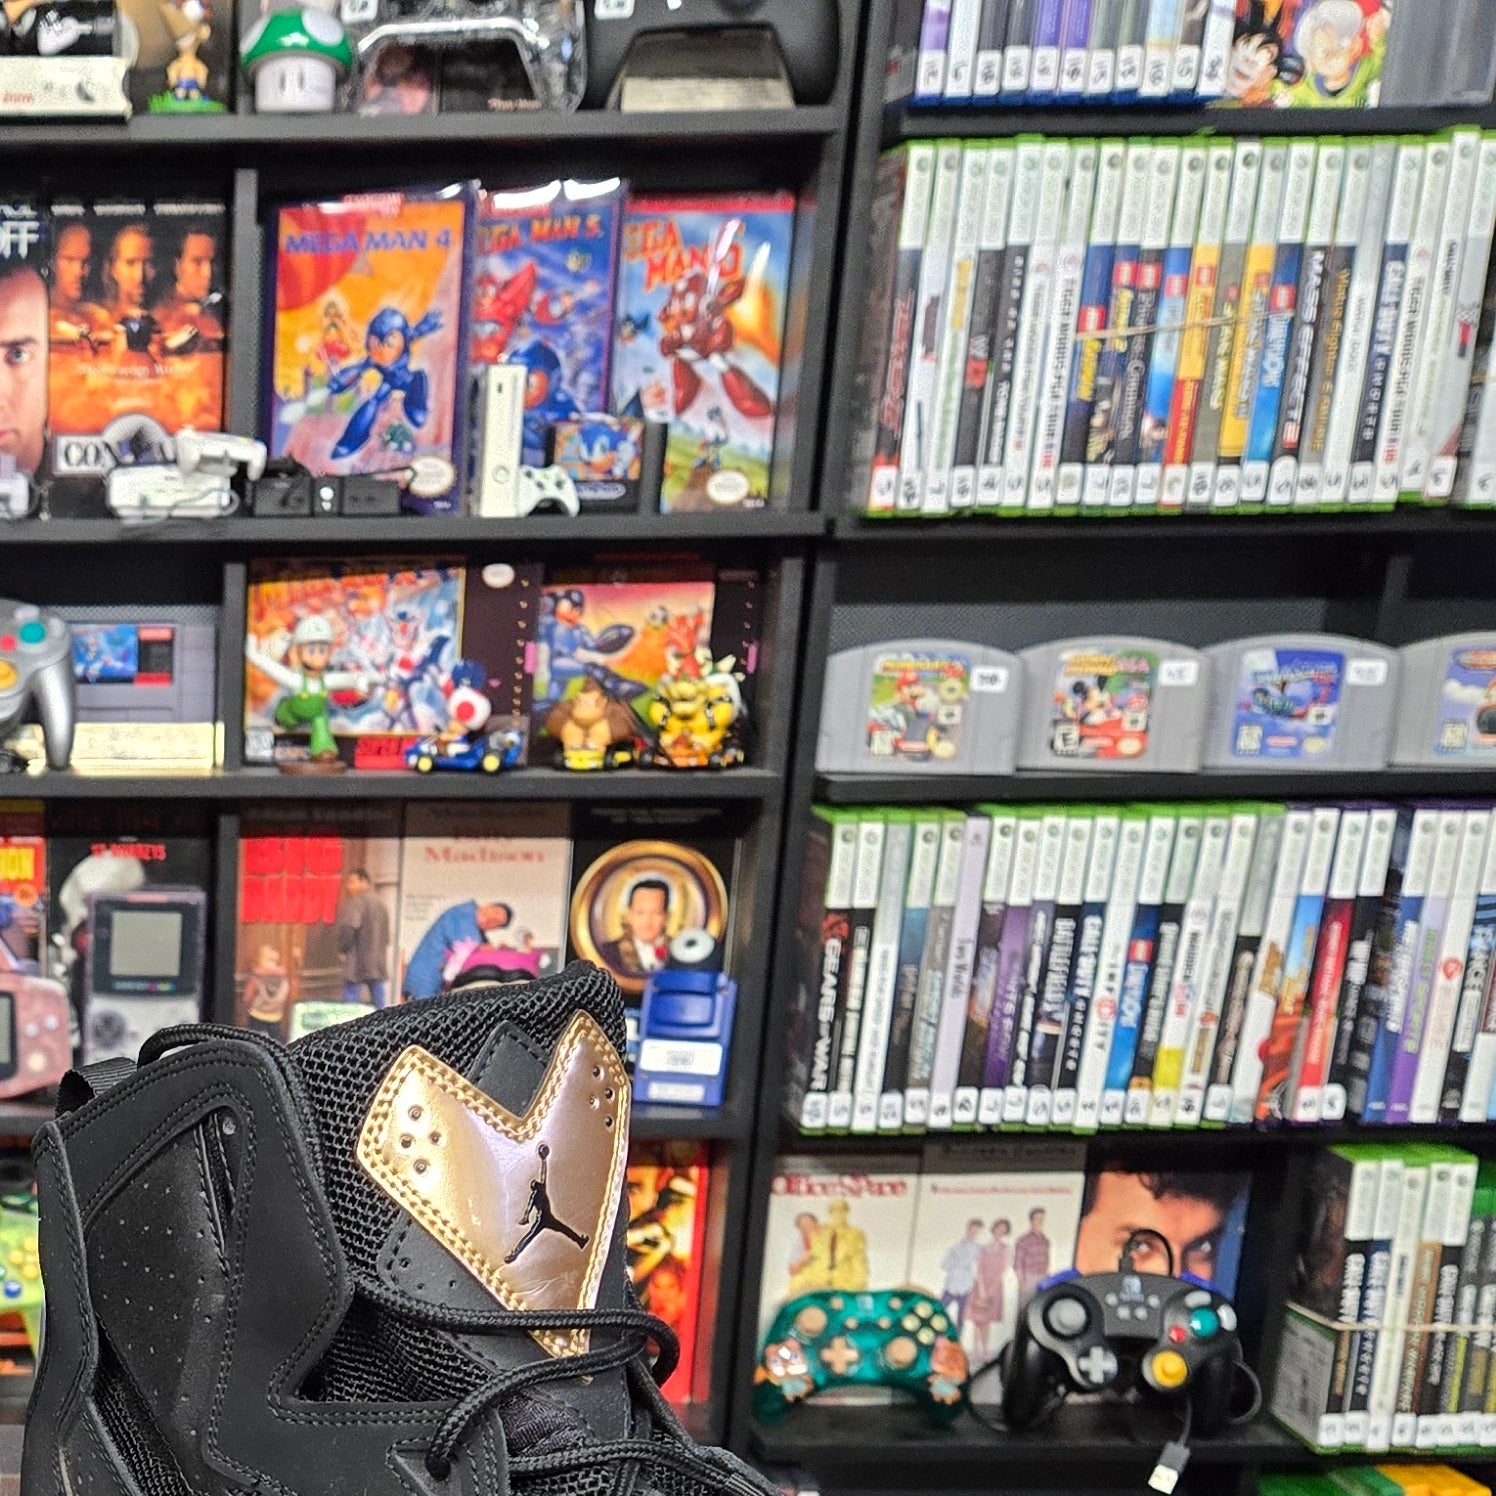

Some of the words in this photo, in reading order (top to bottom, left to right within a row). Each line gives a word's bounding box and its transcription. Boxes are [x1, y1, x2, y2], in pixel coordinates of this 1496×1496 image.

[285, 232, 361, 255] MEGA
[365, 230, 423, 251] MAN
[432, 228, 453, 249] 4
[1301, 250, 1325, 324] MASS
[817, 937, 842, 1023] GEARS
[809, 1036, 832, 1091] WAR
